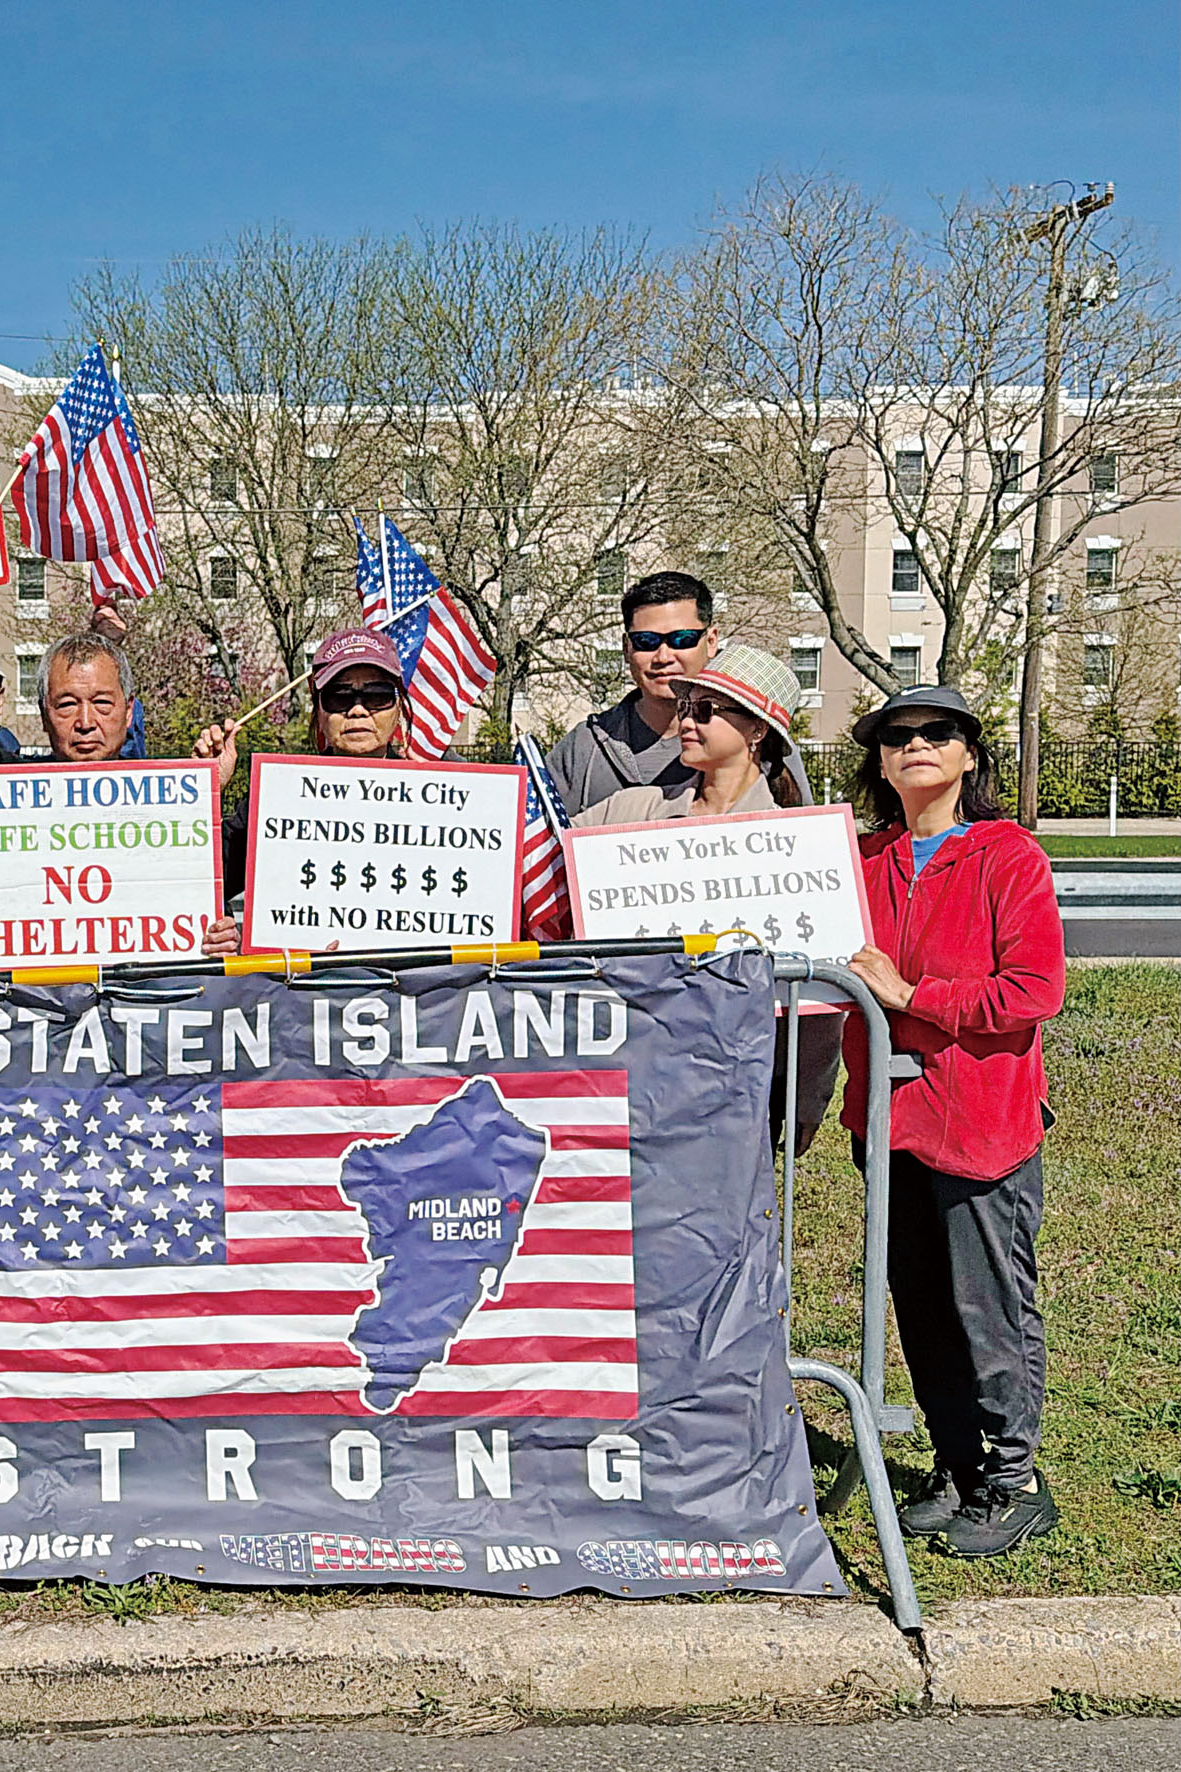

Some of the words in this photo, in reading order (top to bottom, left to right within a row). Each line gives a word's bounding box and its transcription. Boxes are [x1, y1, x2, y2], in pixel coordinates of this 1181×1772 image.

[64, 774, 198, 807] HOMES
[300, 777, 350, 800] New
[357, 780, 413, 803] York
[421, 783, 470, 811] City
[50, 819, 209, 851] SCHOOLS
[264, 817, 365, 843] SPENDS
[373, 824, 502, 850] BILLIONS
[617, 844, 669, 866] New
[677, 835, 737, 860] York
[745, 832, 797, 857] City
[41, 865, 113, 905] NO
[588, 881, 695, 911] SPENDS
[703, 869, 841, 901] BILLIONS
[270, 904, 319, 927] with
[328, 907, 367, 929] NO
[375, 909, 494, 937] RESULTS
[314, 991, 629, 1067] ISLAND
[408, 1198, 502, 1221] MIDLAND
[431, 1219, 502, 1241] BEACH
[219, 1531, 468, 1573] VETERANS
[486, 1545, 561, 1573] AND
[576, 1538, 787, 1580] SENIORS
